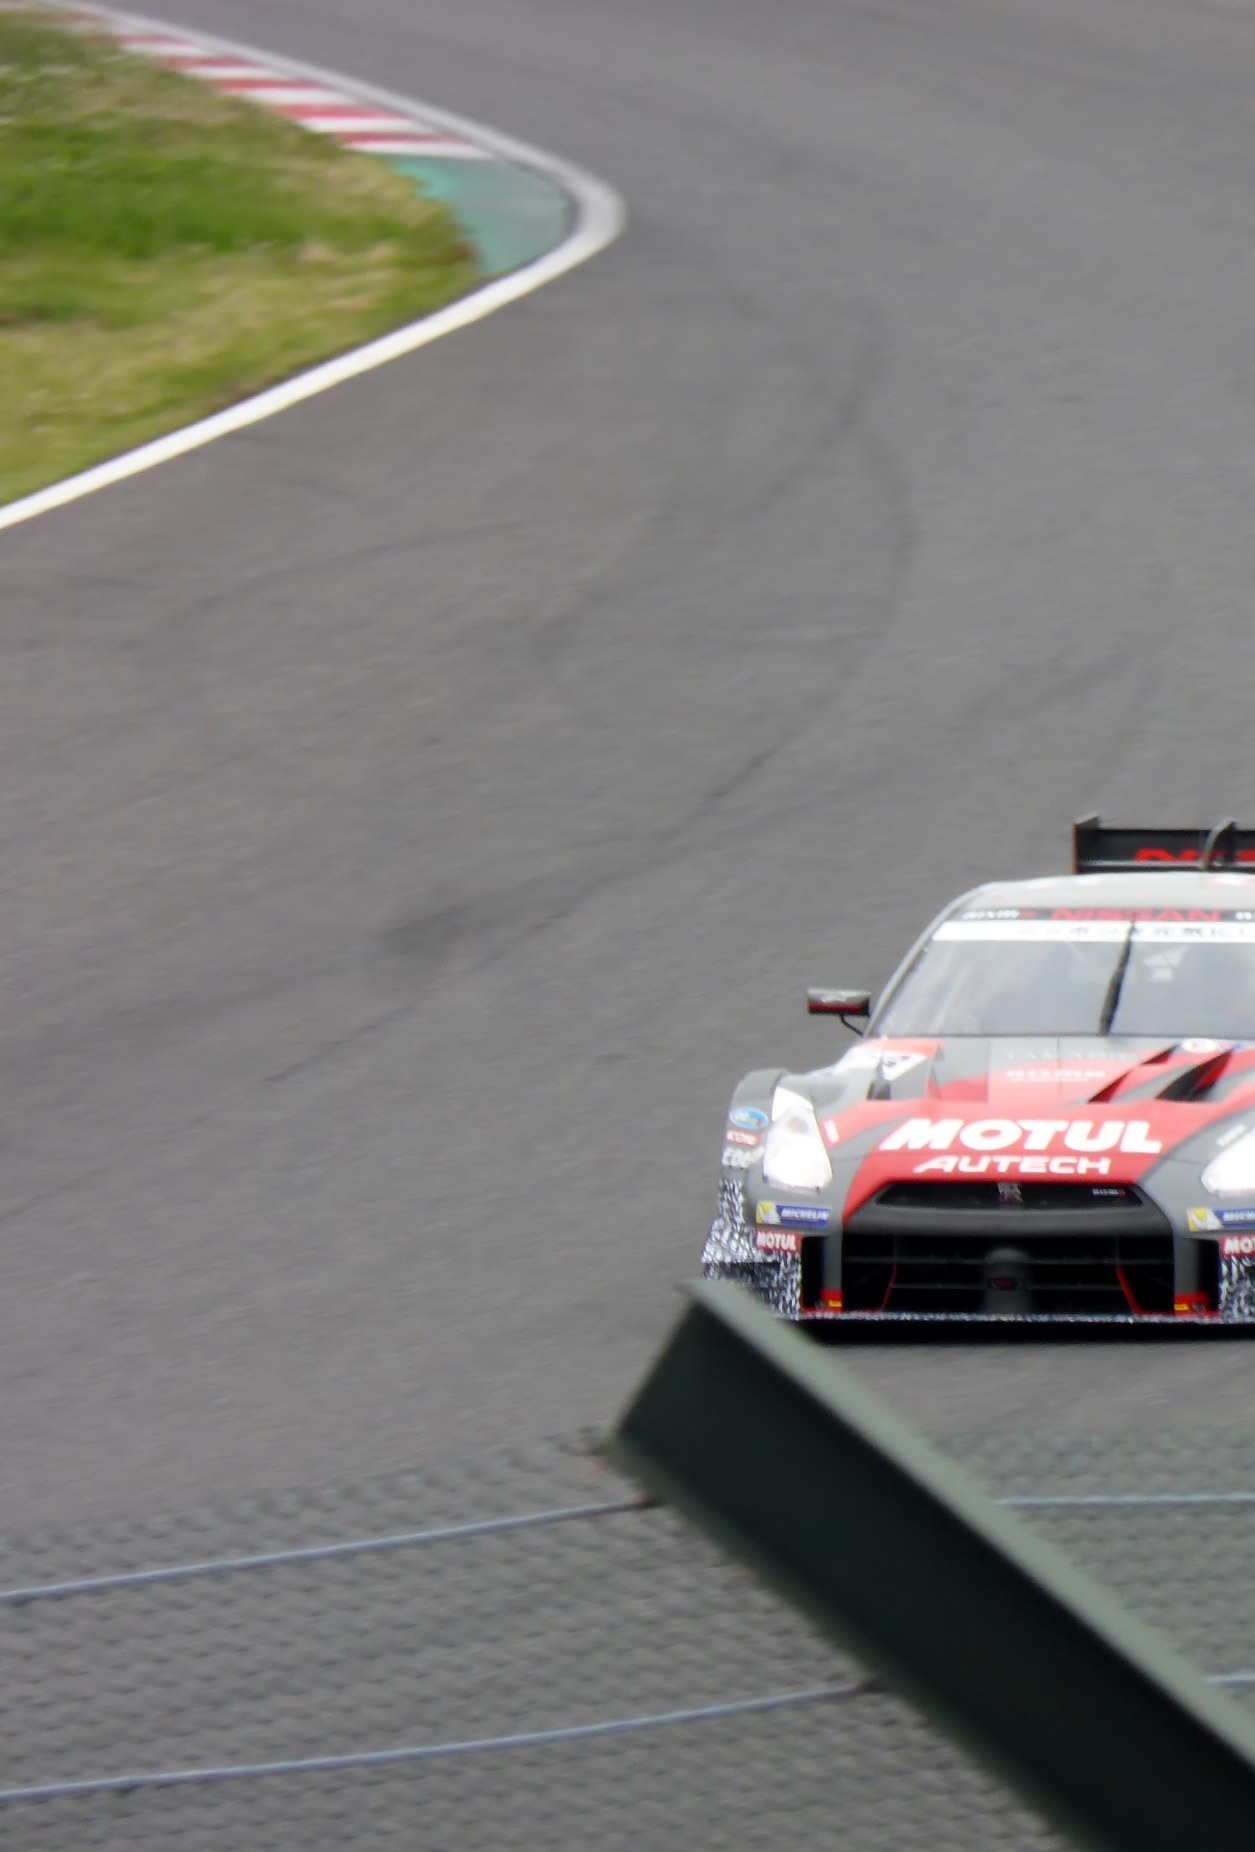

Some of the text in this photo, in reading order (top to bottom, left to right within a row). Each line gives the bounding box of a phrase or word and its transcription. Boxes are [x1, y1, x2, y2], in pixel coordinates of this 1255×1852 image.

[1051, 908, 1222, 922] NISSAN
[878, 1118, 1162, 1153] MOTUL
[913, 1155, 1111, 1175] AUTECH
[781, 1208, 829, 1221] MICHELIN
[755, 1231, 797, 1251] MOTUL
